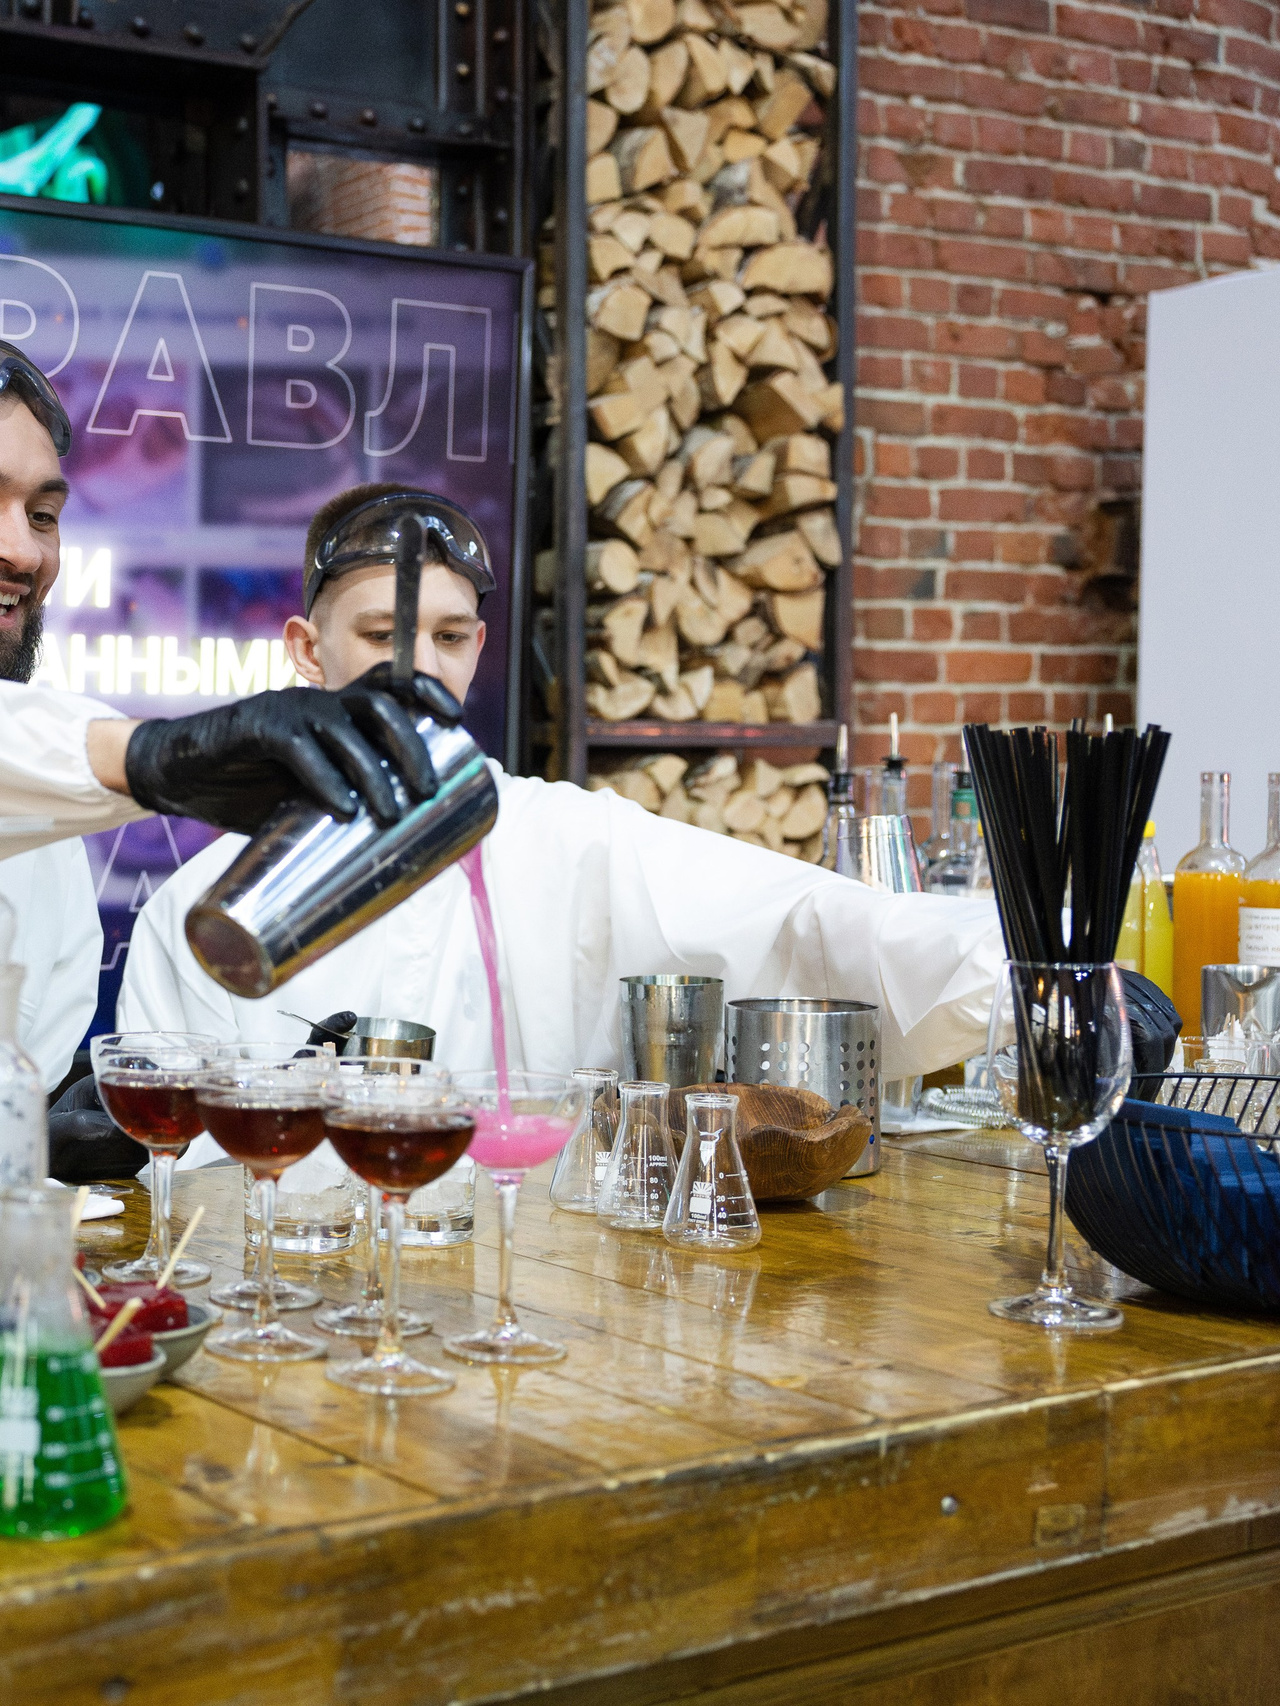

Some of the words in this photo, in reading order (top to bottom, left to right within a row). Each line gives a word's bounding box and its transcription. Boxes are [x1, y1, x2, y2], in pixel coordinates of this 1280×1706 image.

[30, 632, 310, 696] АННЫМИ
[648, 1154, 668, 1162] 100ml
[716, 1195, 726, 1203] 20
[717, 1211, 727, 1219] 40
